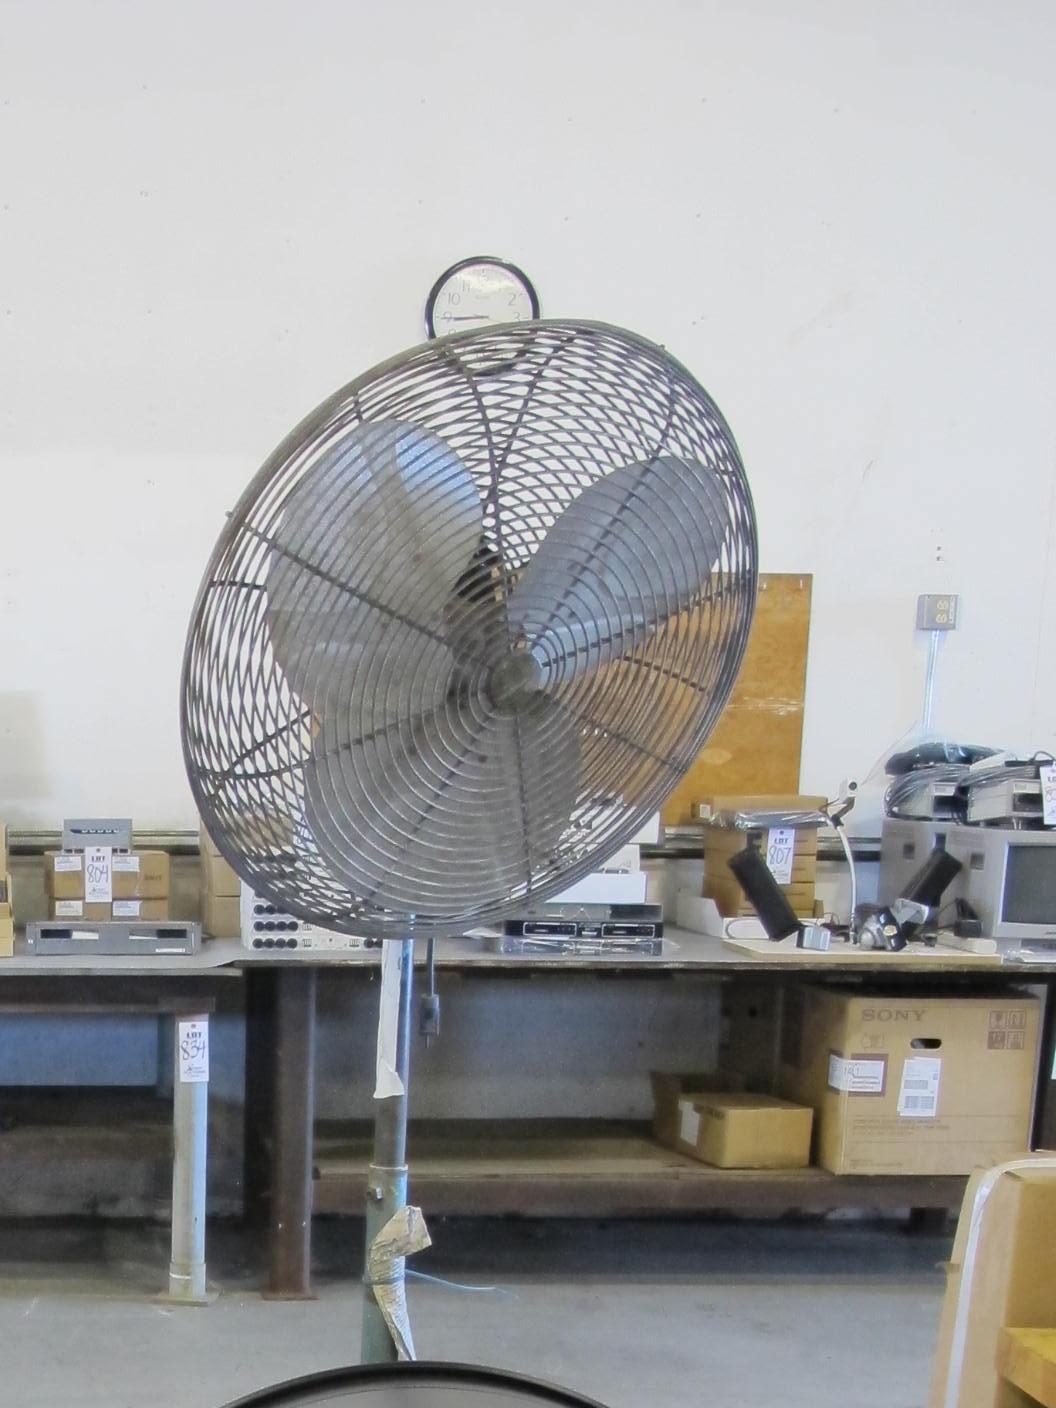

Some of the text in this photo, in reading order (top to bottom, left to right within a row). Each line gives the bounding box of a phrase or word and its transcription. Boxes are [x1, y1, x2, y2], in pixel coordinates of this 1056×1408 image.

[448, 292, 460, 306] 10
[768, 845, 791, 865] 807
[87, 863, 109, 883] 804
[861, 1009, 926, 1022] SONY
[181, 1039, 206, 1060] 834
